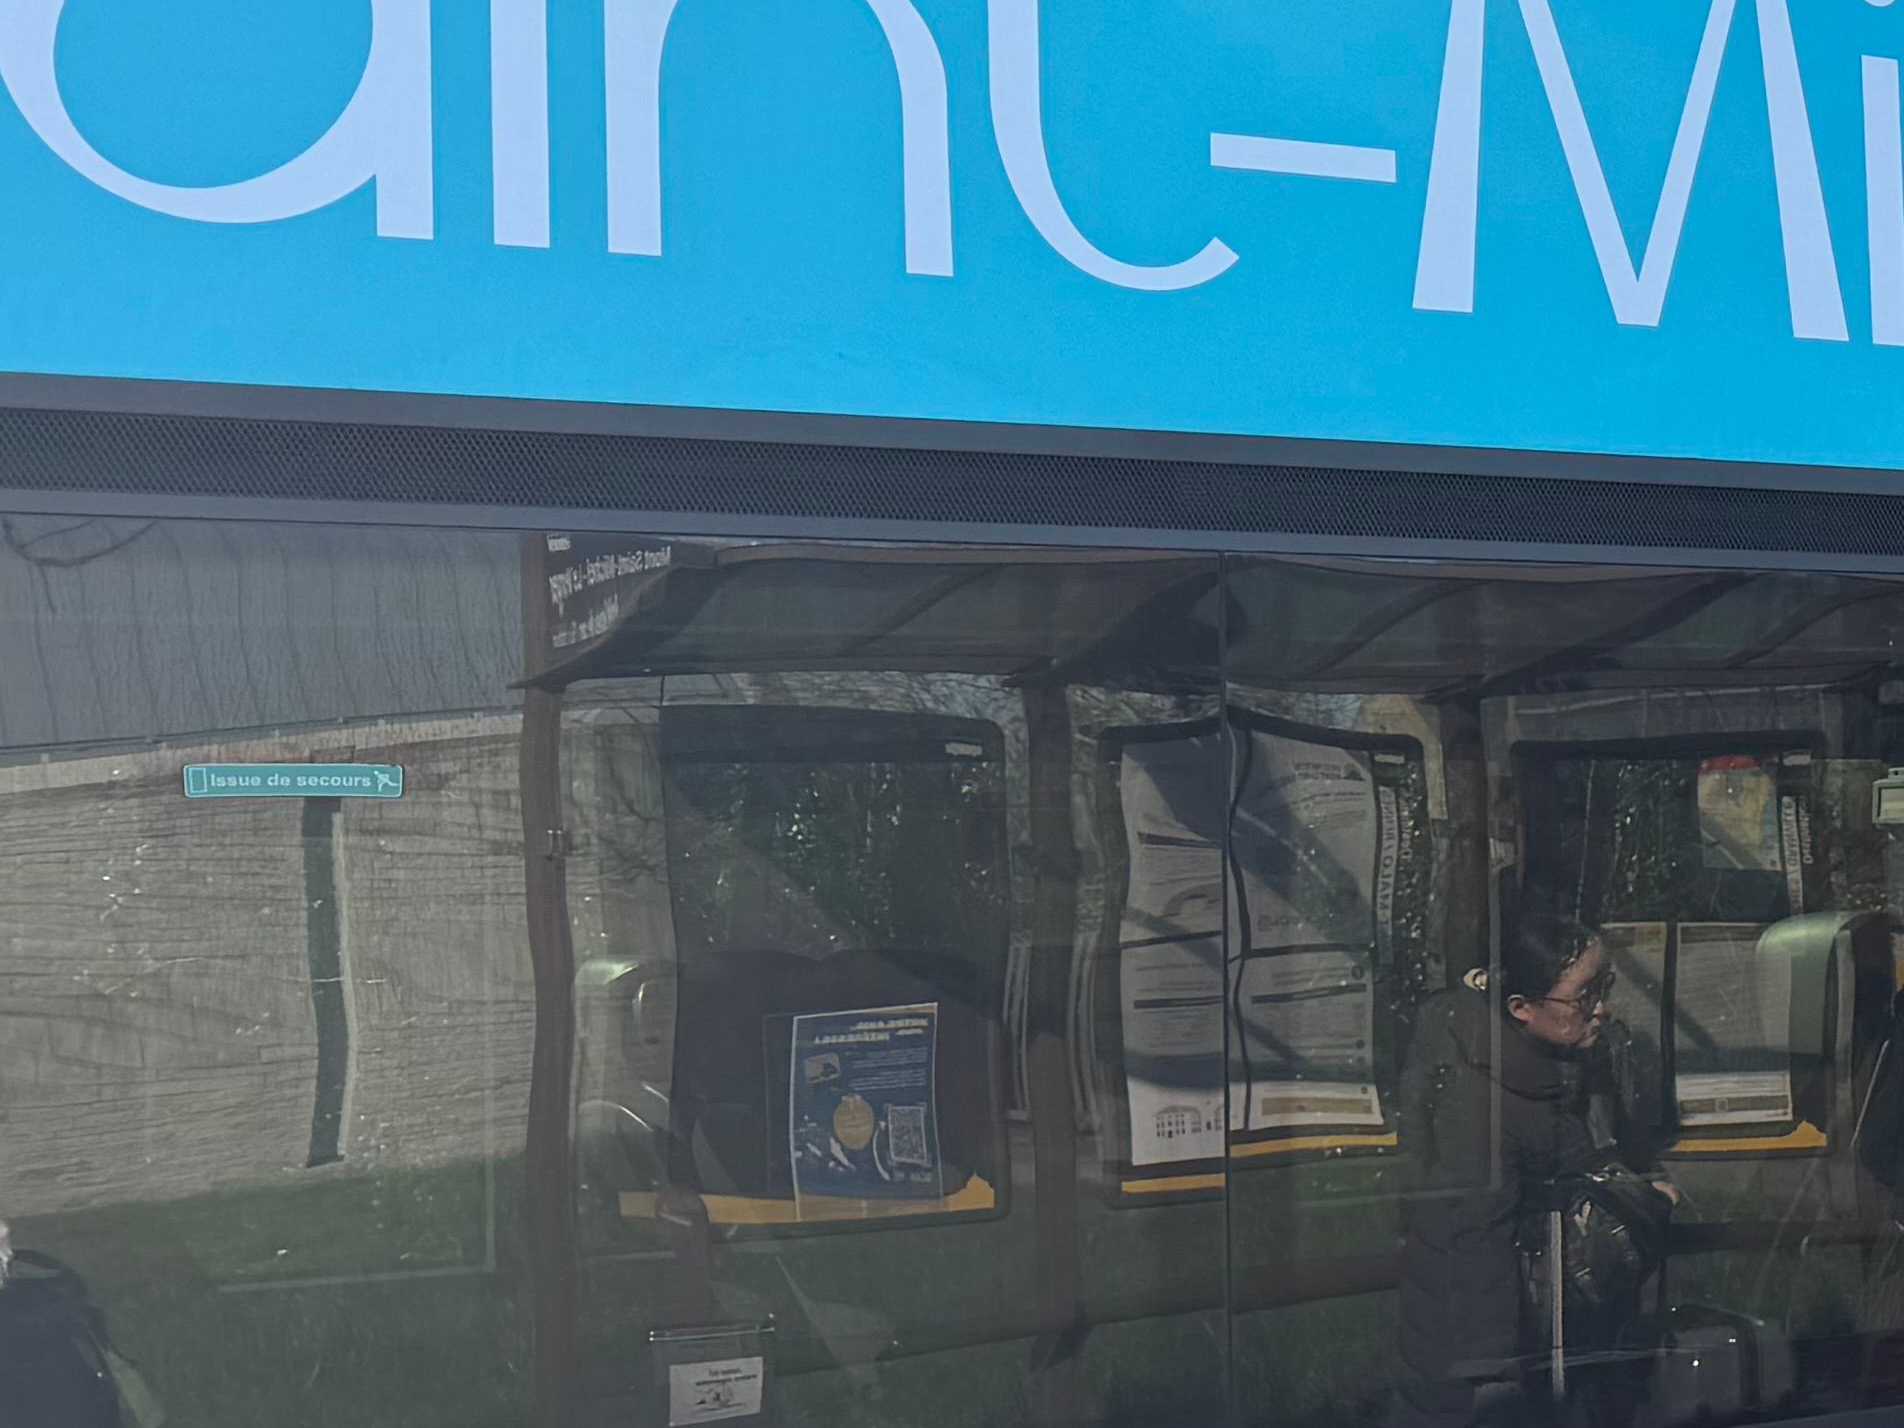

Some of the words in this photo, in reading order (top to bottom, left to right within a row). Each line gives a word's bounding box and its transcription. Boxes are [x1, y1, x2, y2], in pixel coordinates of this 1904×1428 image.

[210, 773, 262, 787] Issue
[267, 772, 291, 787] de
[296, 774, 372, 788] secours
